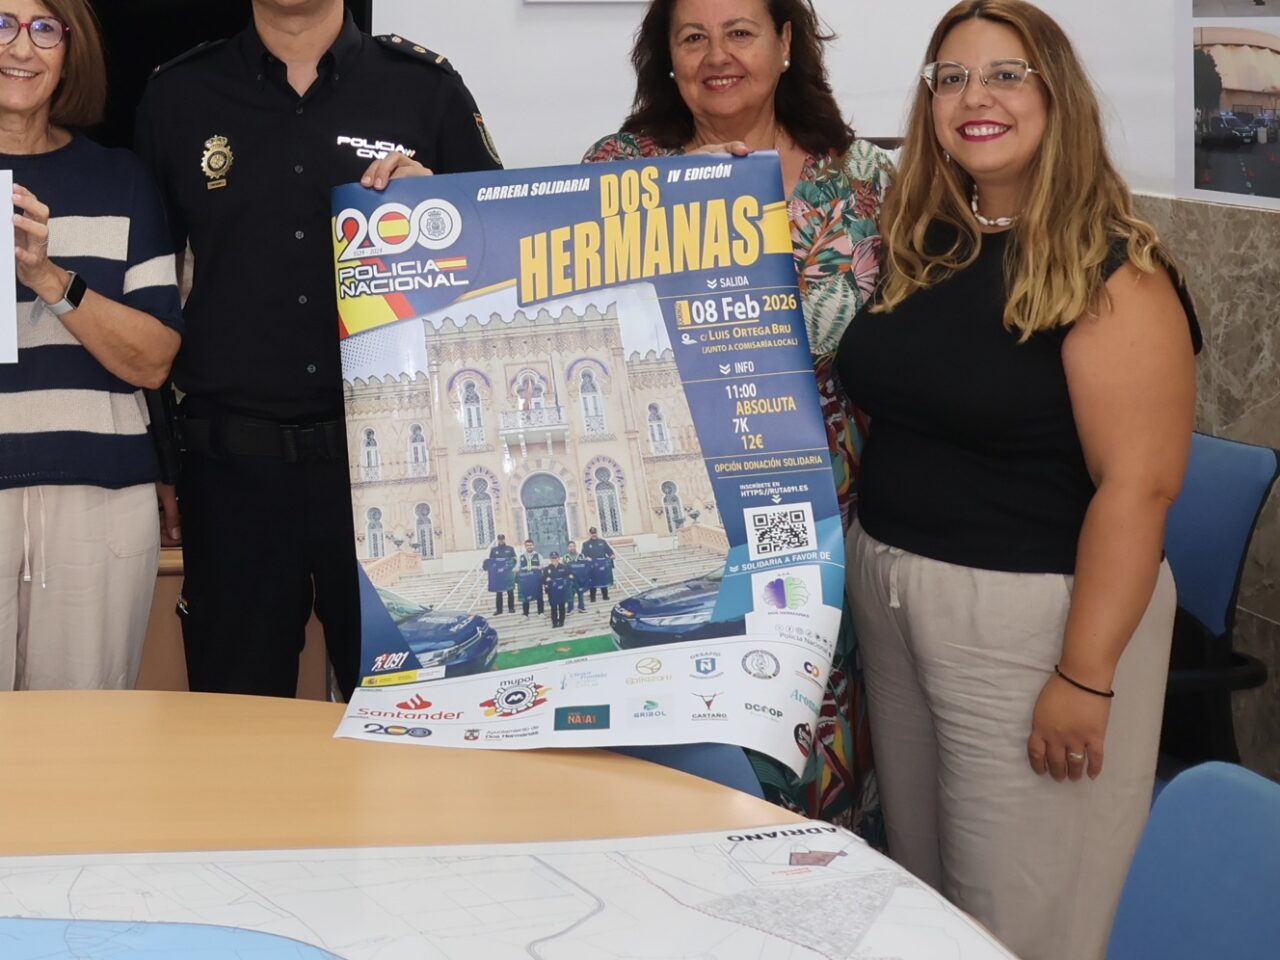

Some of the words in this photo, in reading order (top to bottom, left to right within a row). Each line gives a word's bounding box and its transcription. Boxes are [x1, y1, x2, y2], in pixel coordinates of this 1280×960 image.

[667, 169, 680, 183] IV
[684, 163, 732, 181] EDICIÓN
[477, 183, 528, 201] CARRERA
[530, 178, 590, 196] SOLIDARIA
[600, 166, 660, 218] DOS
[335, 198, 462, 262] 200
[520, 195, 759, 304] HERMANAS
[340, 273, 469, 299] NACIONAL
[720, 276, 749, 288] SALIDA
[692, 300, 718, 323] 08
[721, 294, 760, 320] Feb
[762, 294, 797, 311] 2026
[734, 361, 755, 373] INFO
[725, 383, 757, 399] 11:00
[736, 396, 797, 415] ABSOLUTA
[732, 417, 750, 433] 7K
[741, 434, 764, 450] 12€
[715, 460, 742, 472] OPCIÓN
[744, 458, 781, 470] DONACIÓN
[783, 455, 822, 466] SOLIDARIA
[742, 558, 784, 571] SOLIDARIA
[792, 553, 817, 562] FAVOR
[820, 551, 831, 560] DE
[499, 675, 534, 686] mupol
[358, 707, 464, 720] Santander
[727, 826, 838, 842] ADRIANO
